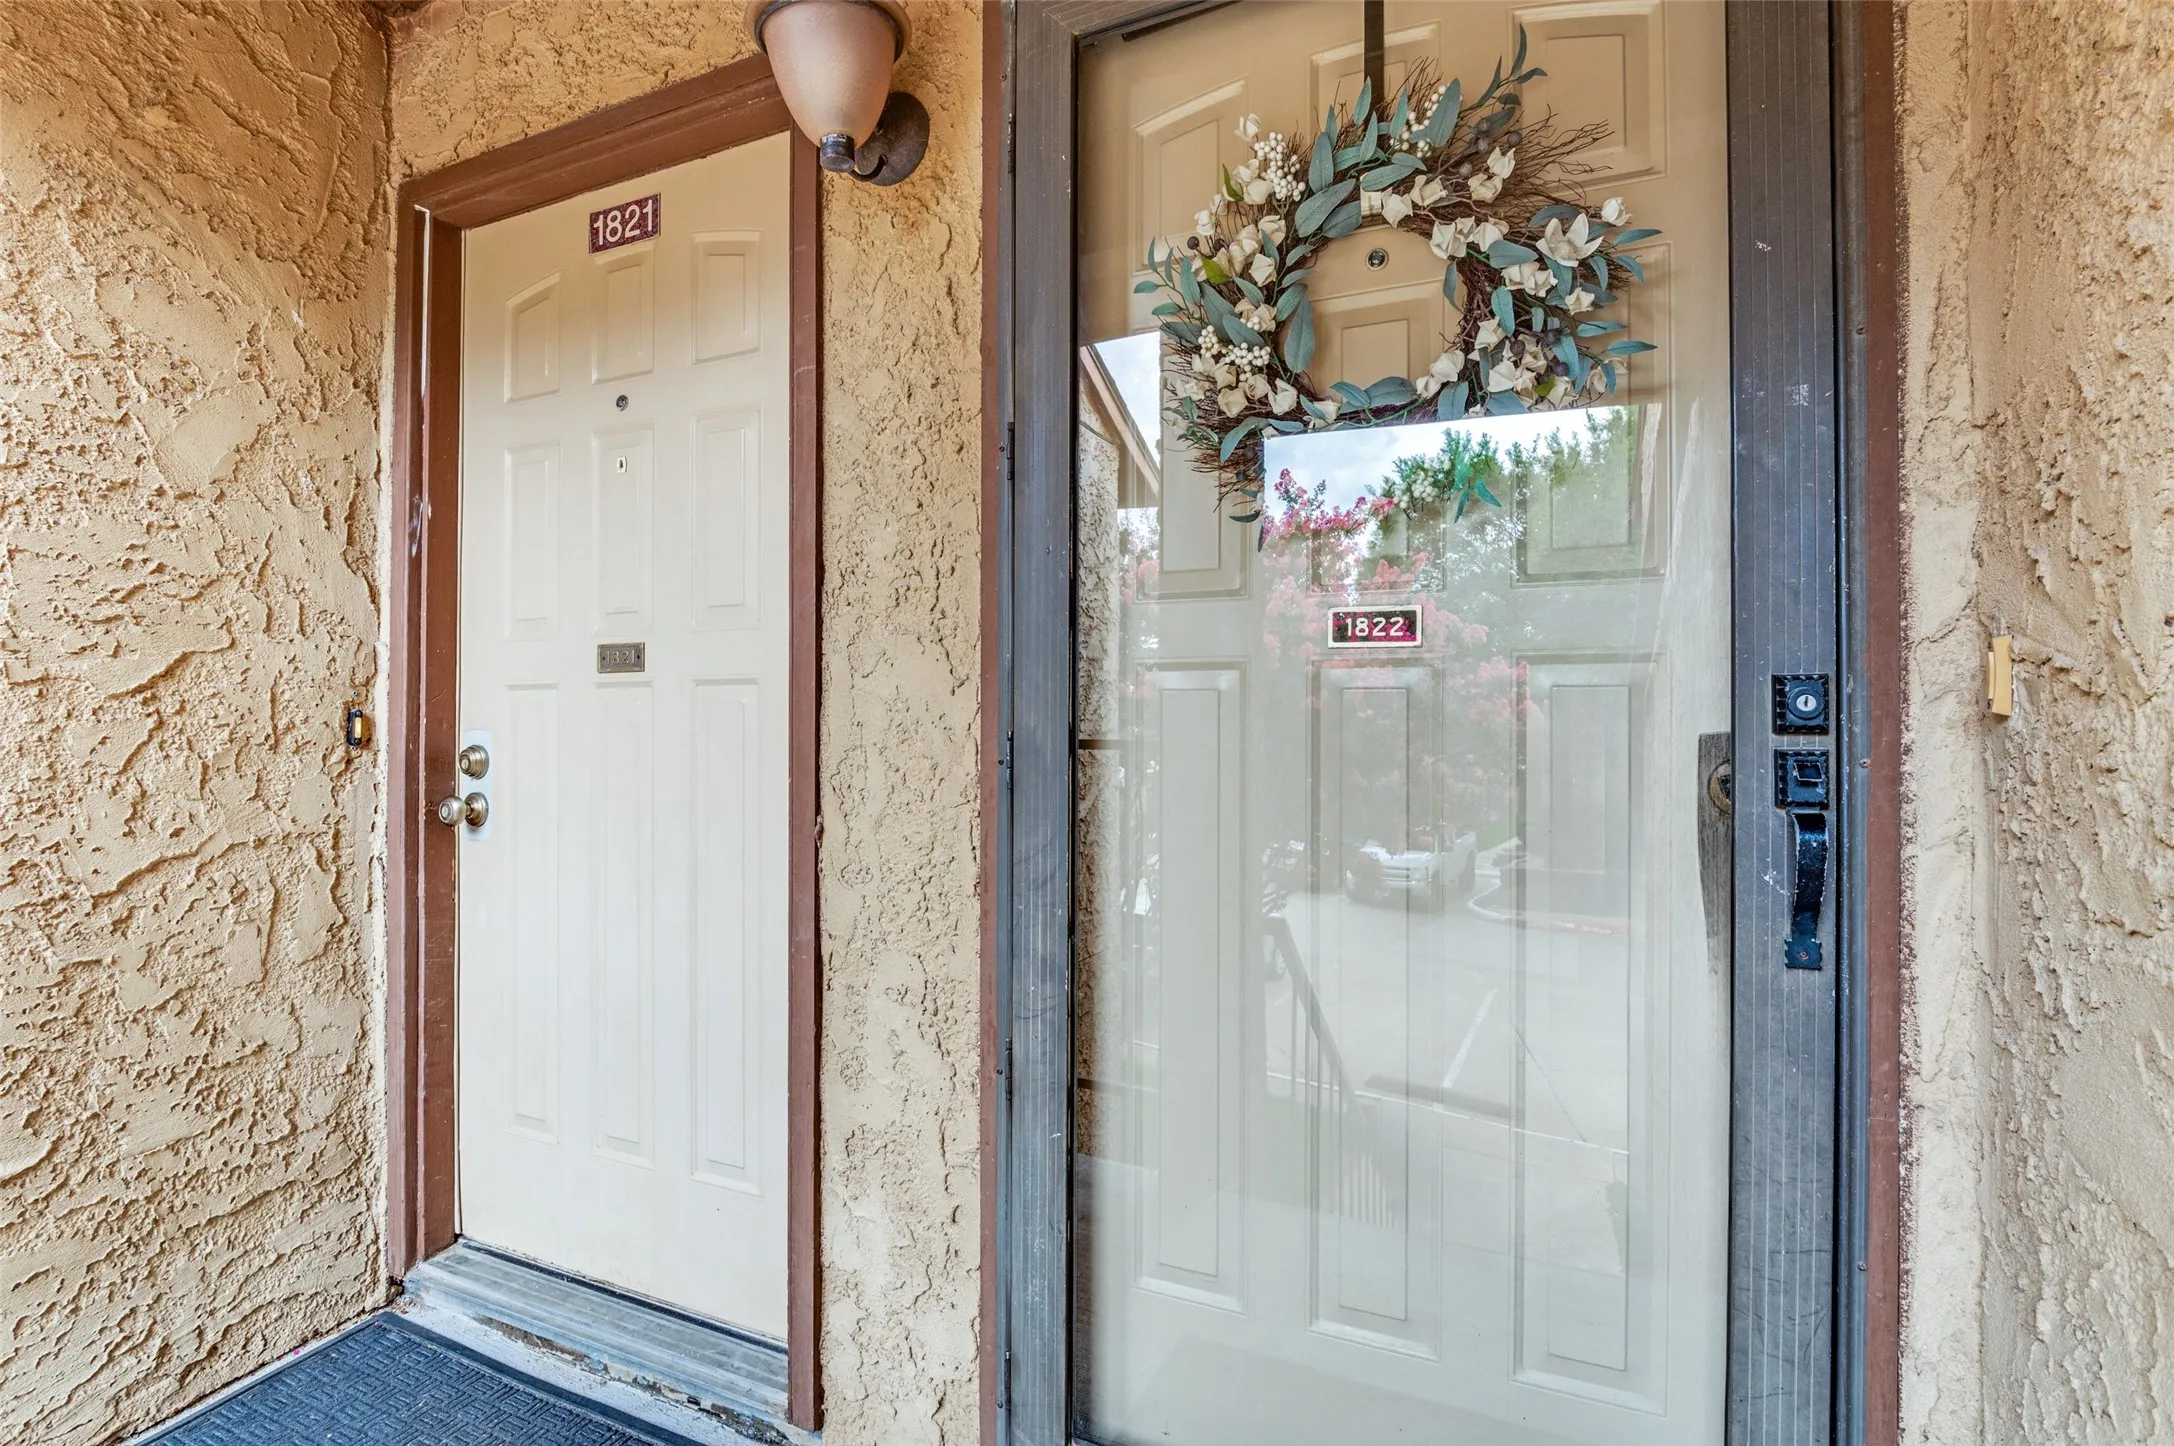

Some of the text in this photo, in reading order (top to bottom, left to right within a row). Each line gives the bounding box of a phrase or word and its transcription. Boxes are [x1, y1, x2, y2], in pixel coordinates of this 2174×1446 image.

[593, 199, 653, 246] 1821
[1345, 616, 1404, 637] 1822
[607, 649, 636, 665] 1821
